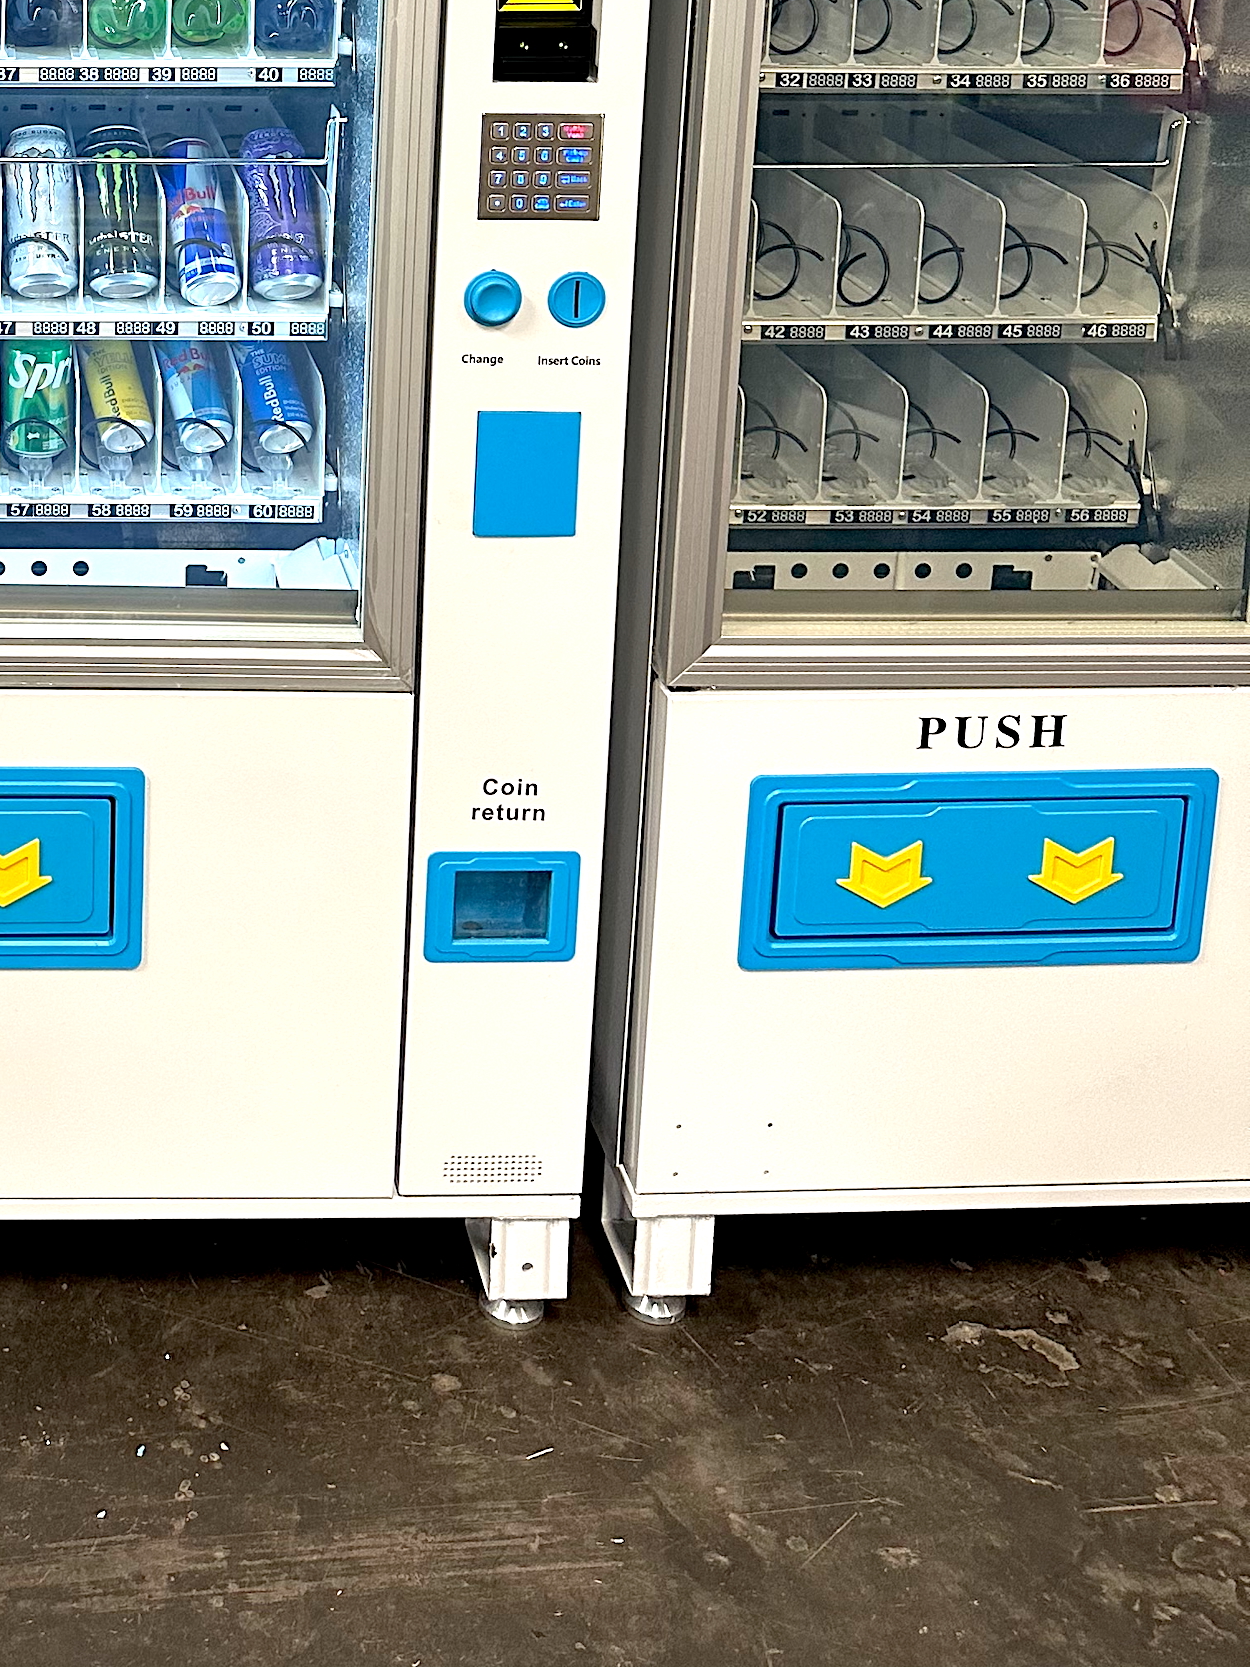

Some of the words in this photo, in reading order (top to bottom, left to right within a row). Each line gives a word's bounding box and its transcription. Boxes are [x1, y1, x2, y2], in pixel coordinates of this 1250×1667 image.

[185, 186, 216, 201] Bull
[1087, 324, 1107, 337] 46
[1111, 324, 1146, 337] 8888
[250, 348, 265, 358] THE
[461, 354, 504, 367] Change
[538, 356, 569, 366] Insert
[571, 356, 601, 366] Coins
[254, 365, 287, 376] EDITION
[1070, 508, 1090, 521] 56
[1093, 508, 1127, 521] 8888
[916, 714, 1068, 750] PUSH
[482, 778, 539, 796] Coin
[471, 804, 546, 822] return
